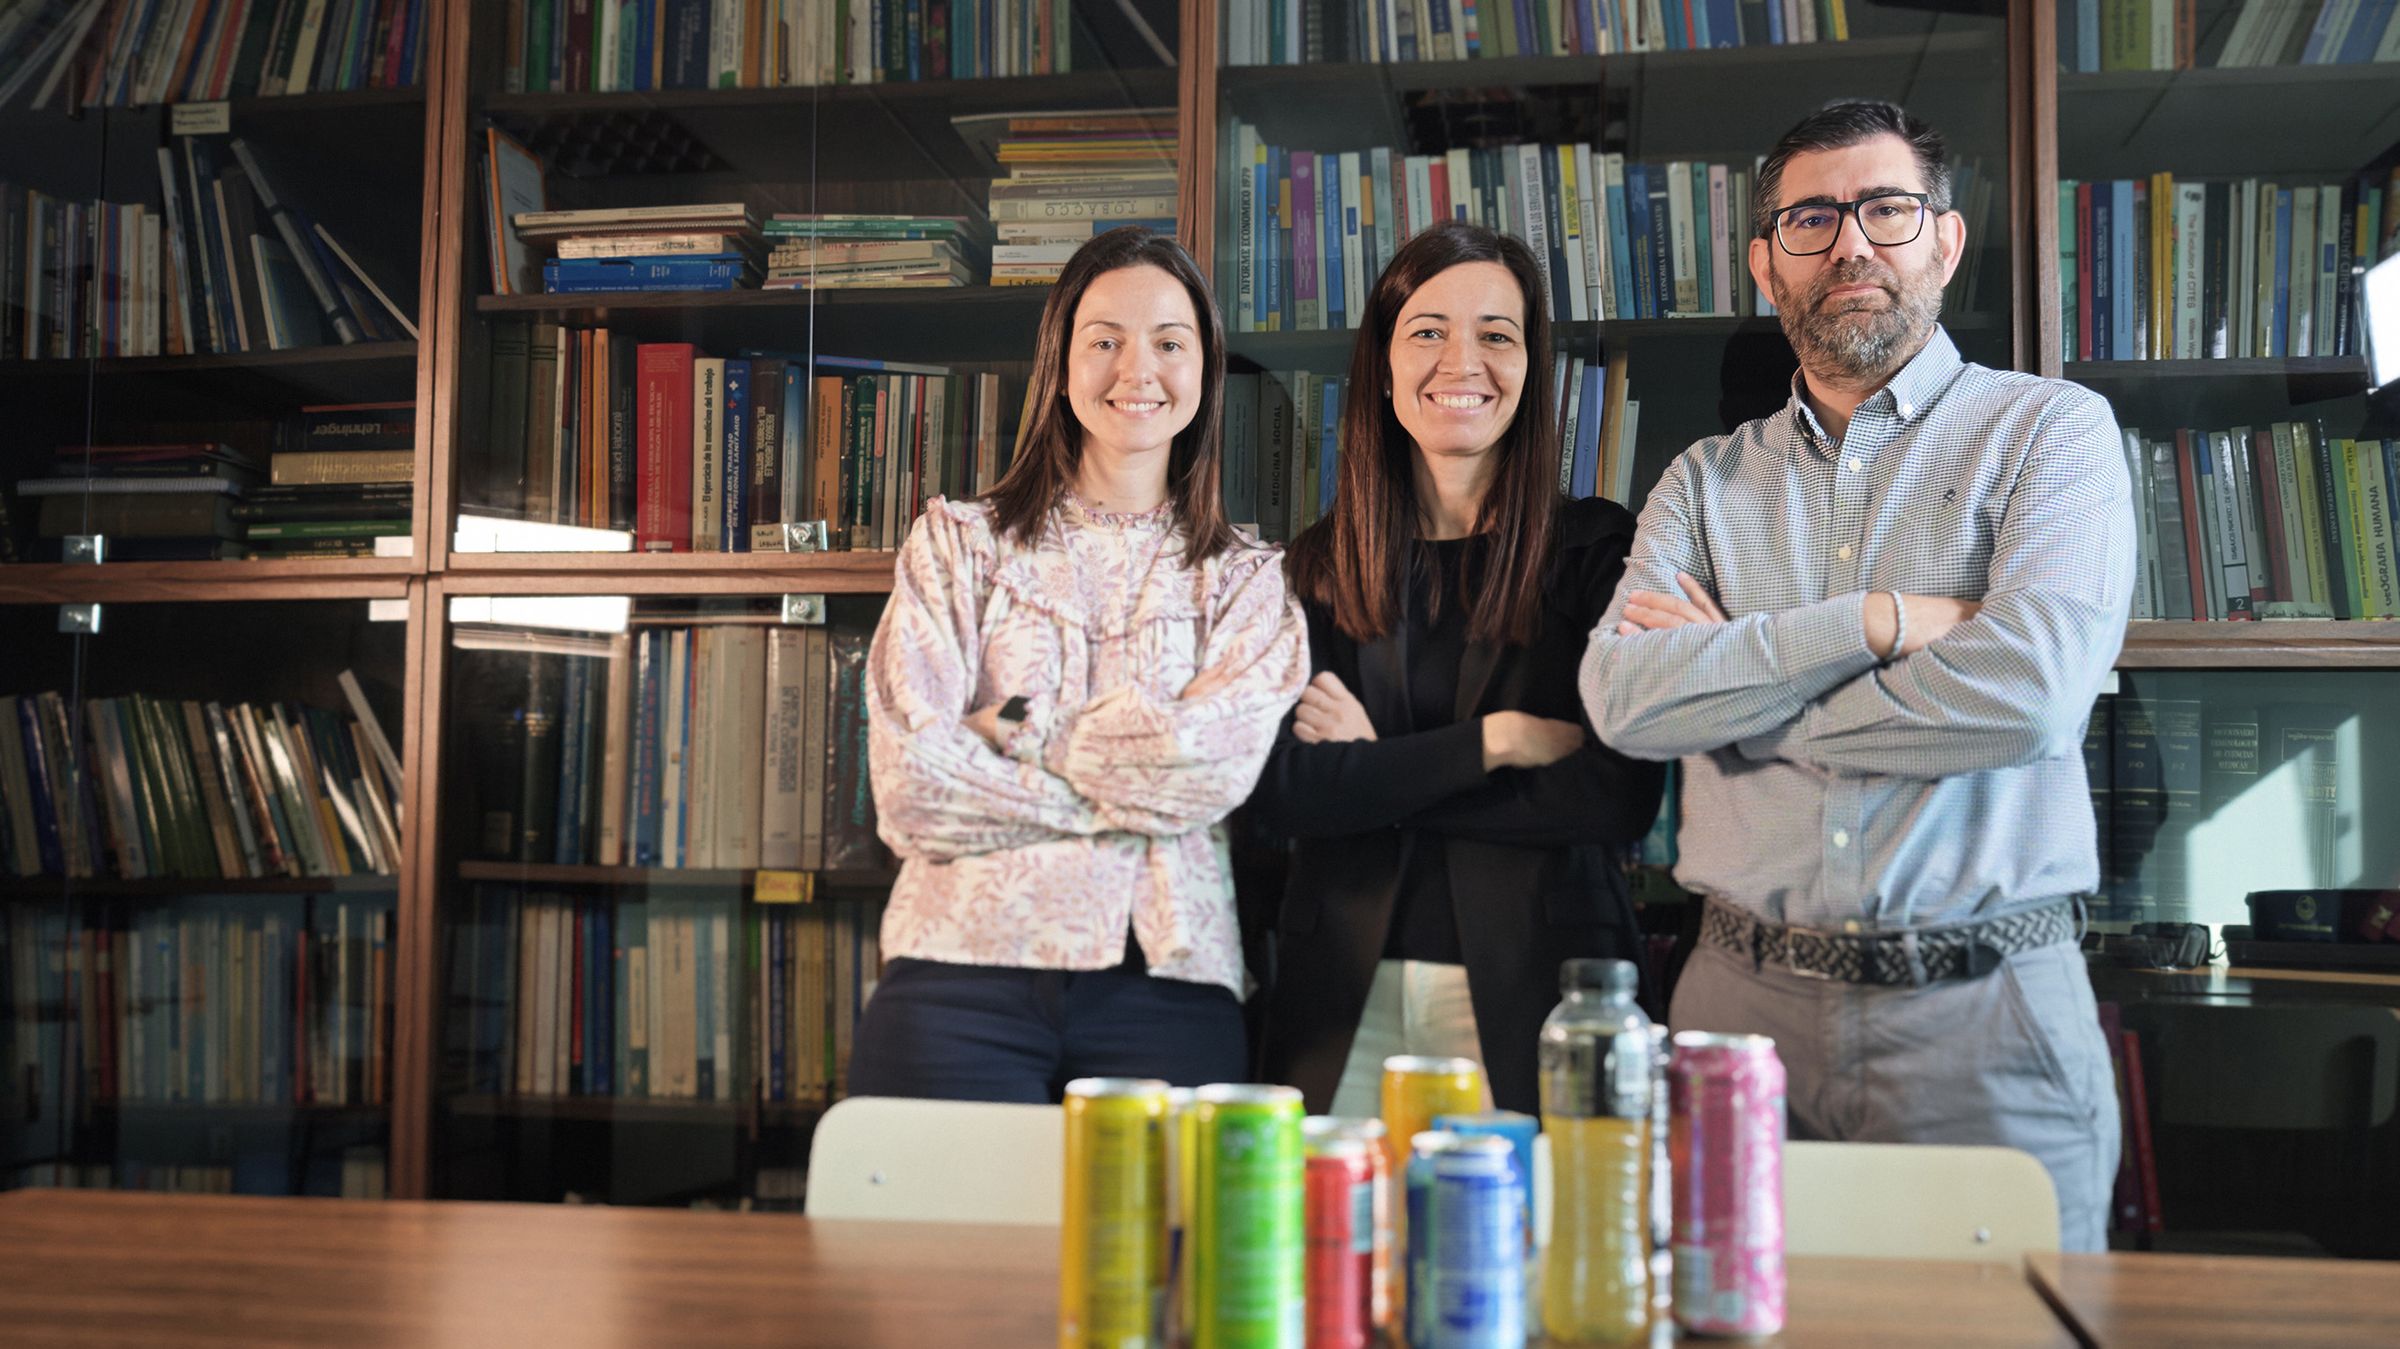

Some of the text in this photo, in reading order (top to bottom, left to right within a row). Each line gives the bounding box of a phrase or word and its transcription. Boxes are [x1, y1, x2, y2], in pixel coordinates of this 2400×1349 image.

[1525, 157, 1539, 182] SOCIALES
[1045, 203, 1138, 217] TOBACCO
[1527, 184, 1541, 211] SERVICIOS
[1240, 167, 1252, 295] INFORME ECONOMICO 1979
[1529, 211, 1542, 224] LOS
[1530, 224, 1542, 232] DE
[2187, 213, 2196, 229] The
[2187, 230, 2196, 268] Evolution
[2341, 212, 2353, 259] HEALTHY
[1655, 204, 1669, 301] ECONOMIA DE LA SALUD
[2187, 270, 2196, 278] of
[2339, 261, 2352, 292] CITIES
[2187, 281, 2196, 308] CITES
[704, 363, 715, 390] trabajo
[704, 391, 713, 403] del
[703, 404, 713, 437] medicina
[757, 406, 765, 419] DEL
[312, 422, 382, 437] Lehninger
[703, 438, 712, 446] la
[756, 419, 765, 451] PERSONAL
[1562, 416, 1577, 460] ENFERMERIA
[611, 411, 624, 481] salud laboral
[703, 447, 712, 457] de
[764, 414, 775, 477] RIESGOS LABORALES
[1271, 404, 1282, 507] MEDICINA SOCIAL
[702, 457, 714, 489] ejercicio
[2225, 495, 2232, 504] DE
[2369, 485, 2392, 606] GEOGRAFIA HUMANA
[2235, 598, 2246, 610] 2
[788, 686, 800, 792] CANCER INCIDENCE
[852, 726, 868, 825] Epidemiology
